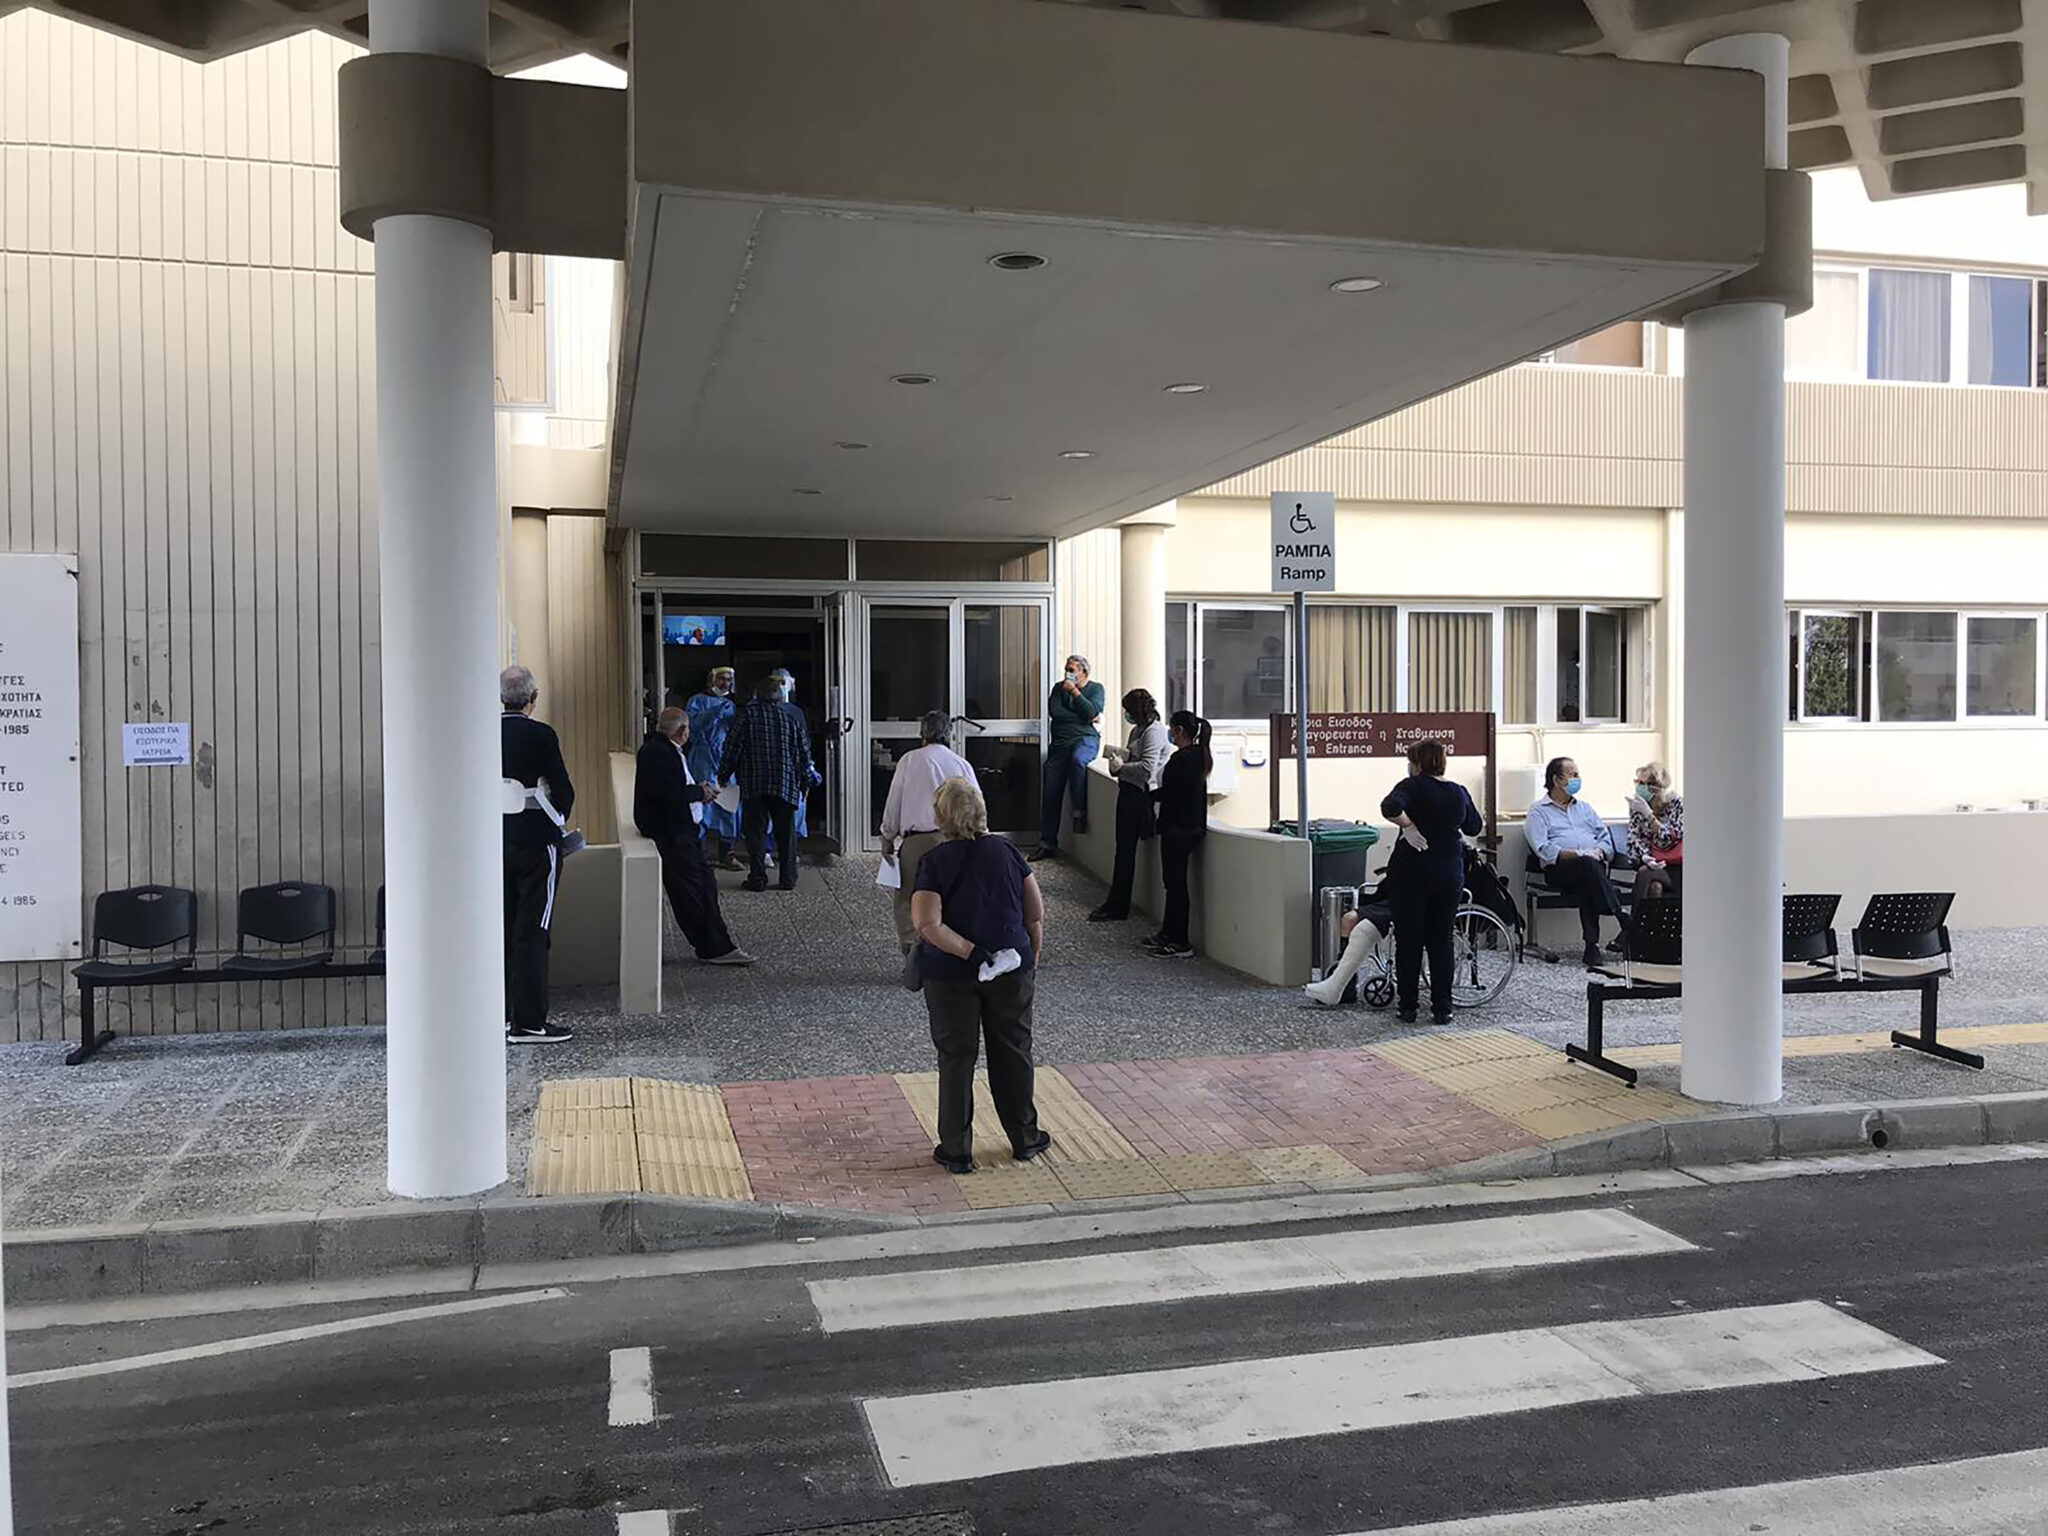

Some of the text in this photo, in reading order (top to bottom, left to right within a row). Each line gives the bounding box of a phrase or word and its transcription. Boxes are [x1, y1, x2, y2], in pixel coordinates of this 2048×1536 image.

[1275, 544, 1331, 558] ΡΑΜΠΑ
[1281, 566, 1326, 582] Ramp
[0, 675, 25, 686] ΓΕΣ
[1328, 716, 1373, 730] Εισοδος
[1290, 729, 1369, 742] Ααγορευεται
[1325, 742, 1373, 754] Entrance
[13, 895, 37, 906] 1985
